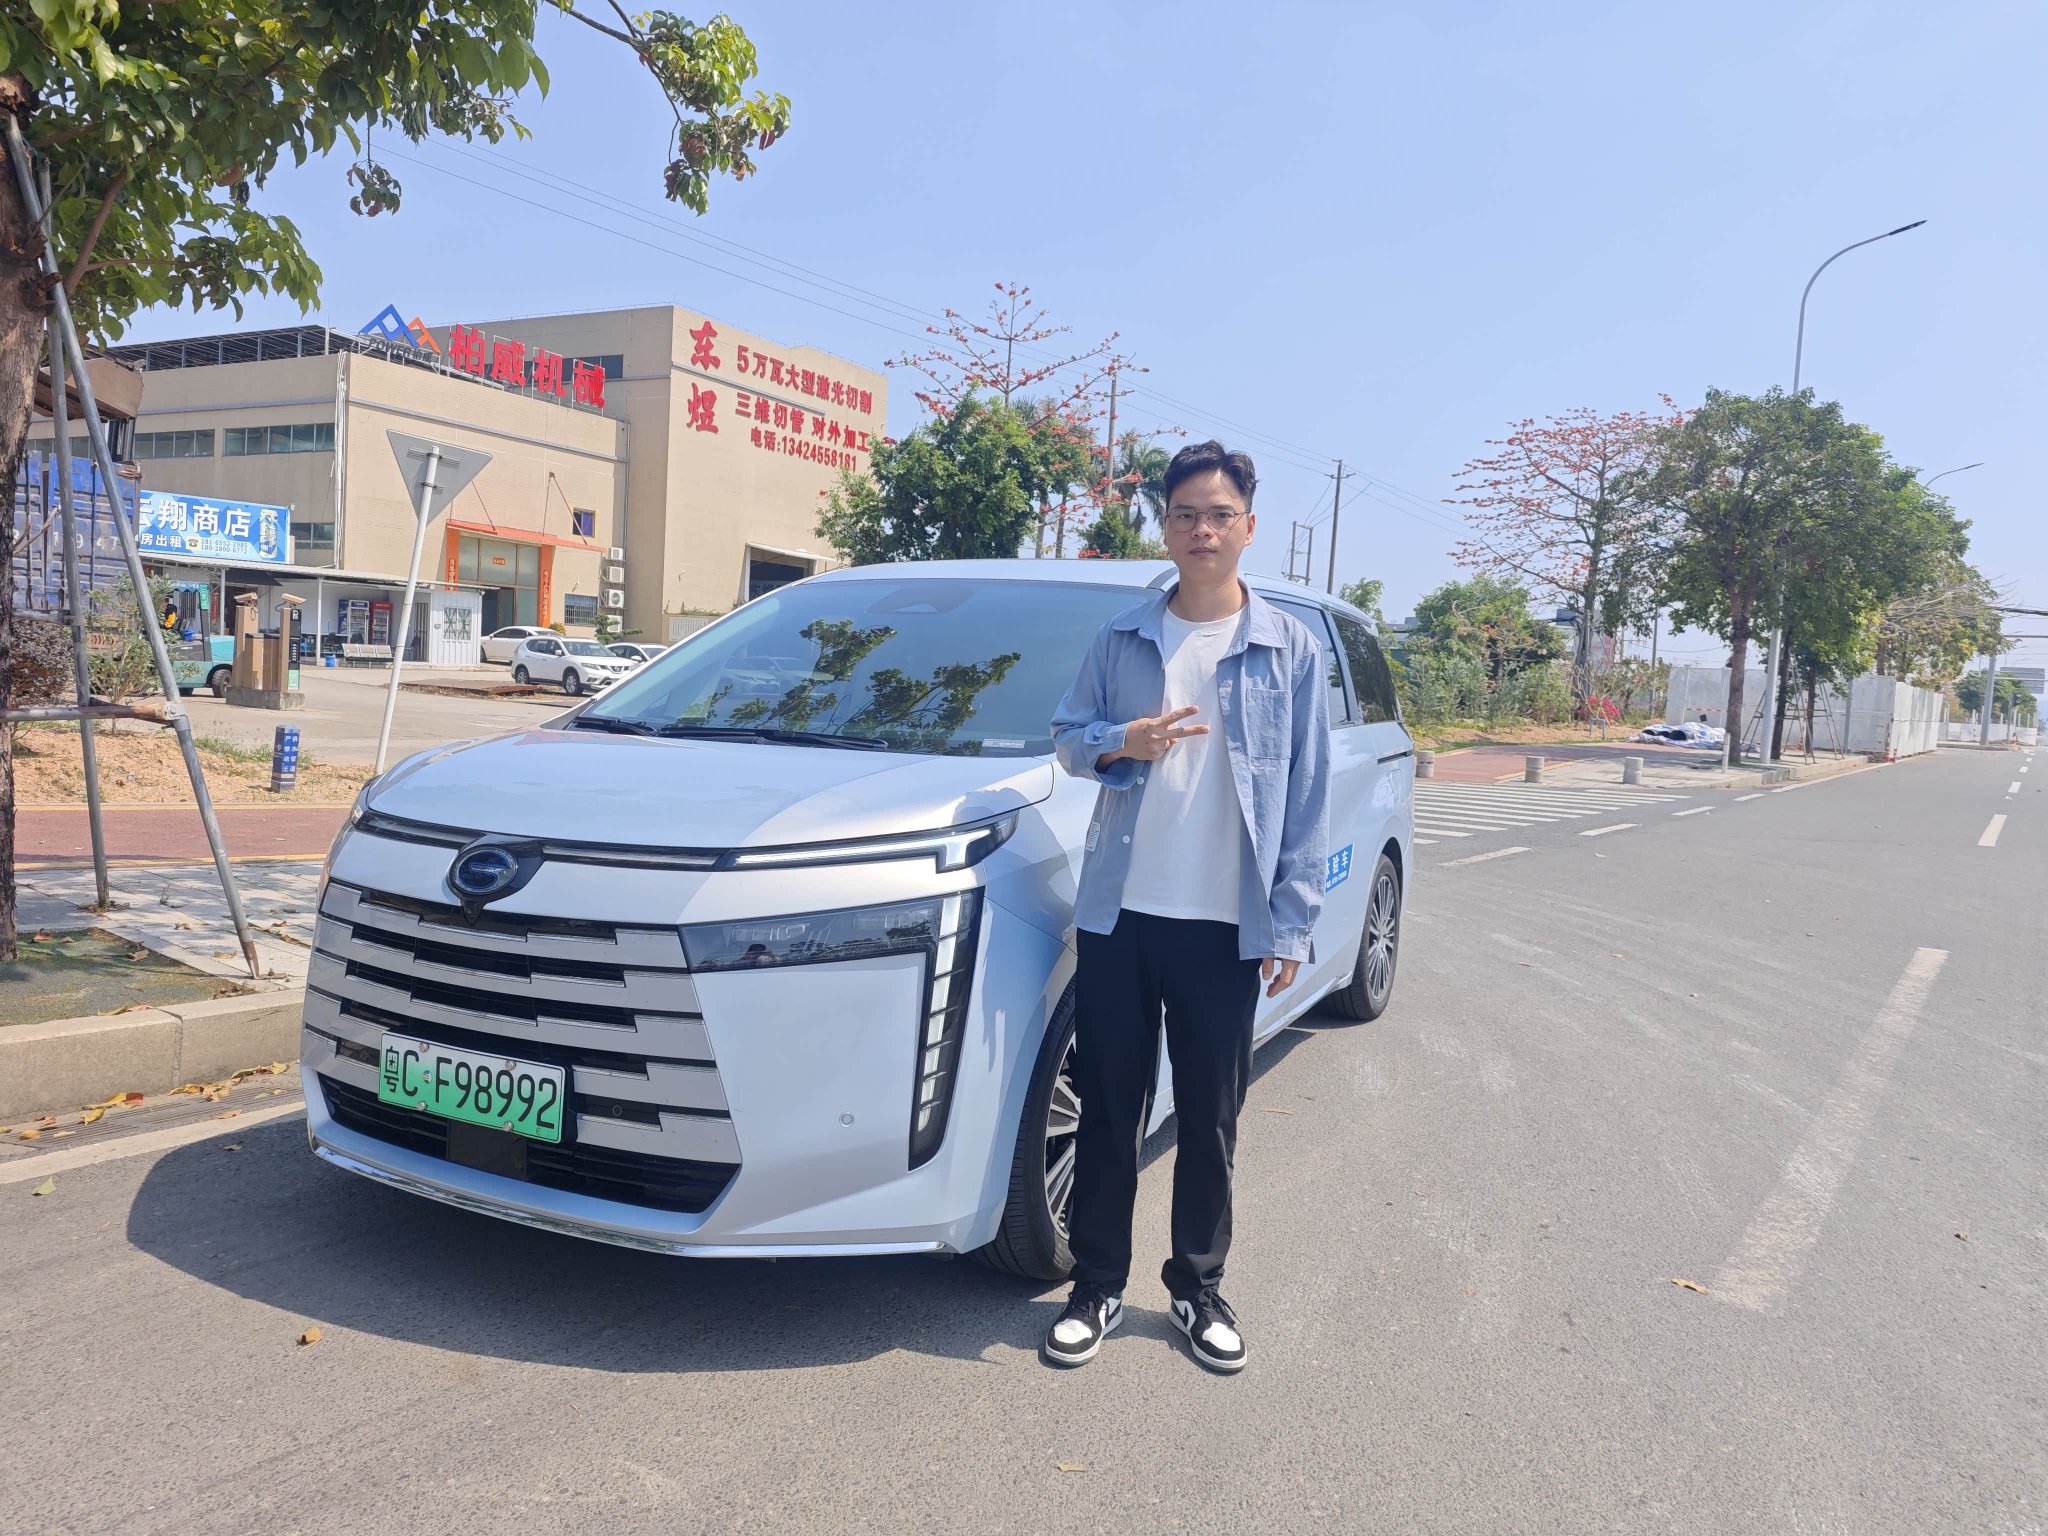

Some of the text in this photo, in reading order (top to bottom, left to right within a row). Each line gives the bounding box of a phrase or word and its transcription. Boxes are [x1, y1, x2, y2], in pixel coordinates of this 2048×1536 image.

[449, 323, 605, 409] 柏威机械
[686, 320, 721, 434] 东煜
[736, 344, 872, 415] 5万瓦大型激光切割
[735, 391, 872, 453] 三维切管 对外加工
[1327, 849, 1349, 874] 验车
[383, 1045, 558, 1130] 粤C F98992
